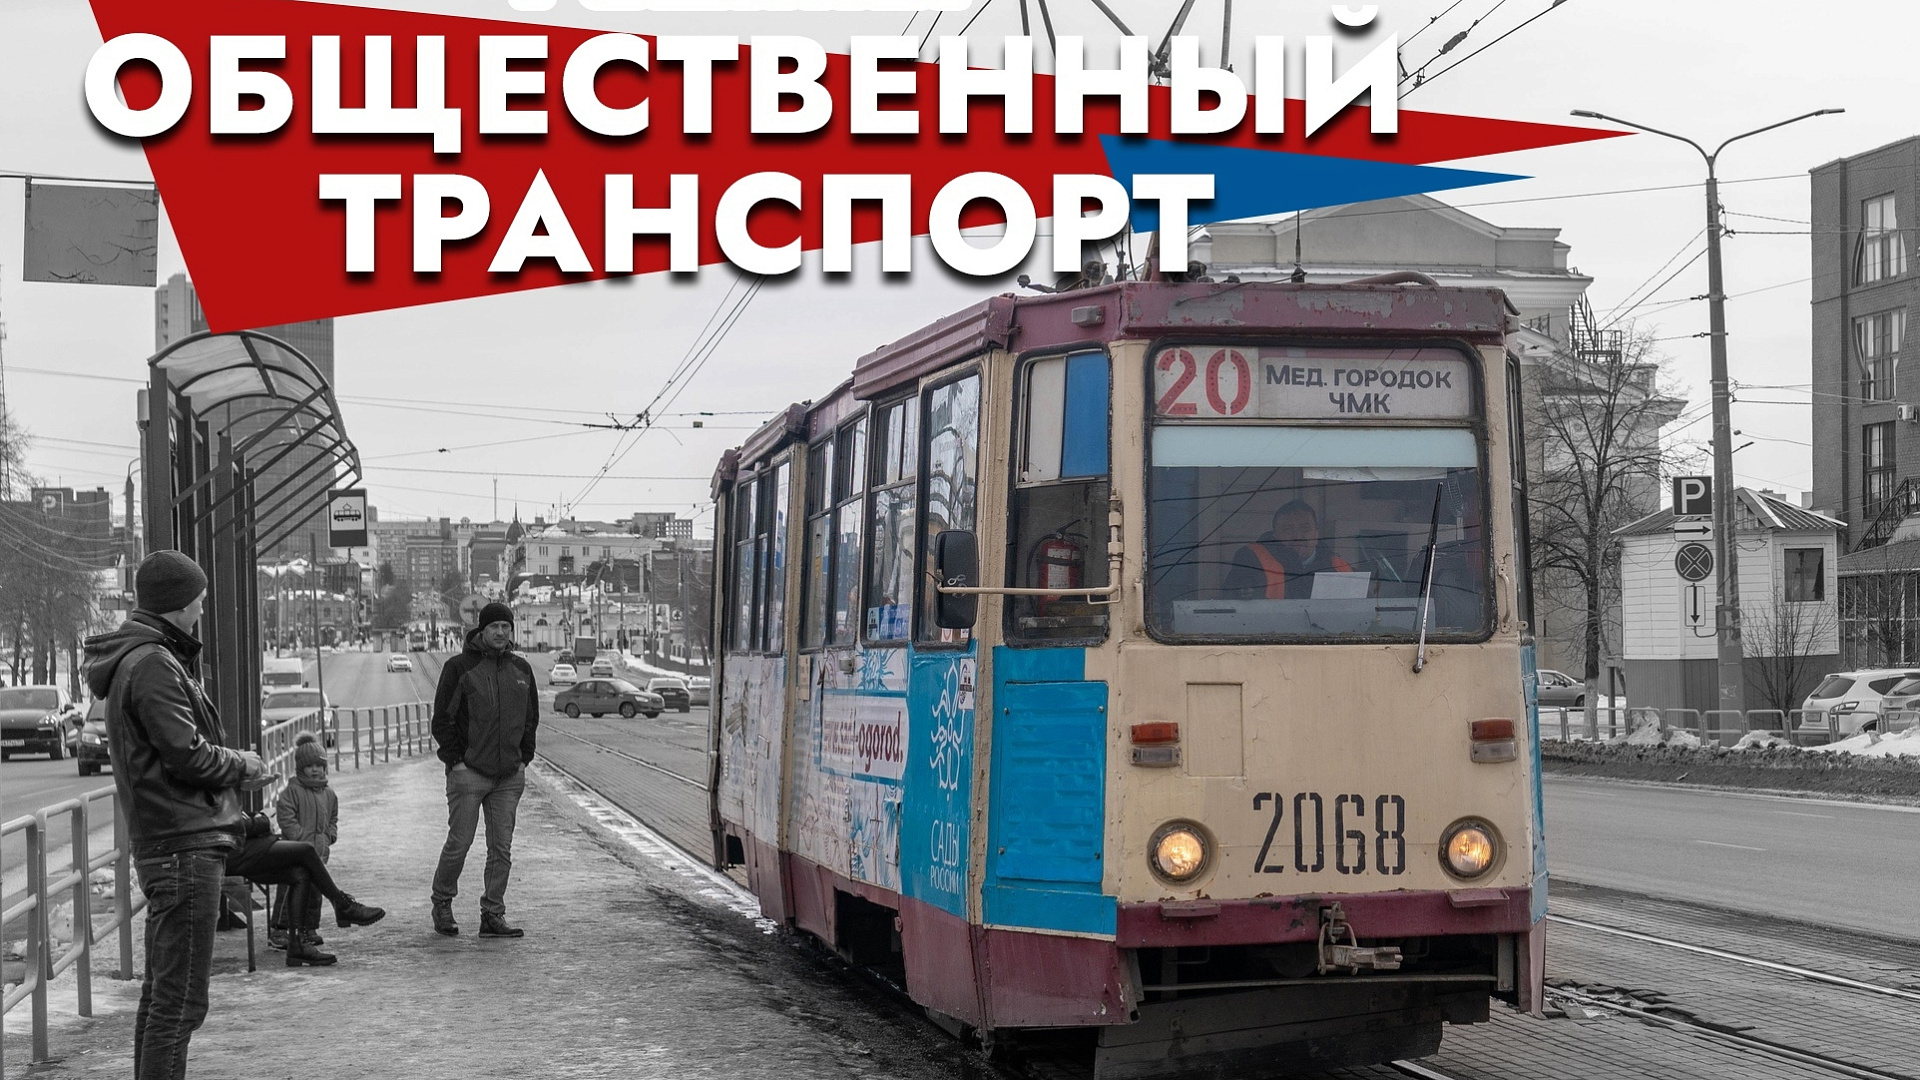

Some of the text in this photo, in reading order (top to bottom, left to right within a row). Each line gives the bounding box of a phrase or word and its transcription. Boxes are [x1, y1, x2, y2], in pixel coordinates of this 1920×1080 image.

[1157, 348, 1251, 415] 20
[1265, 364, 1452, 390] МЕД. ГОРОДОК
[1329, 391, 1390, 414] ЧМК
[1681, 478, 1705, 514] P
[930, 819, 960, 868] САДЫ
[1253, 792, 1406, 876] 2068
[930, 864, 960, 895] РОССИИ
